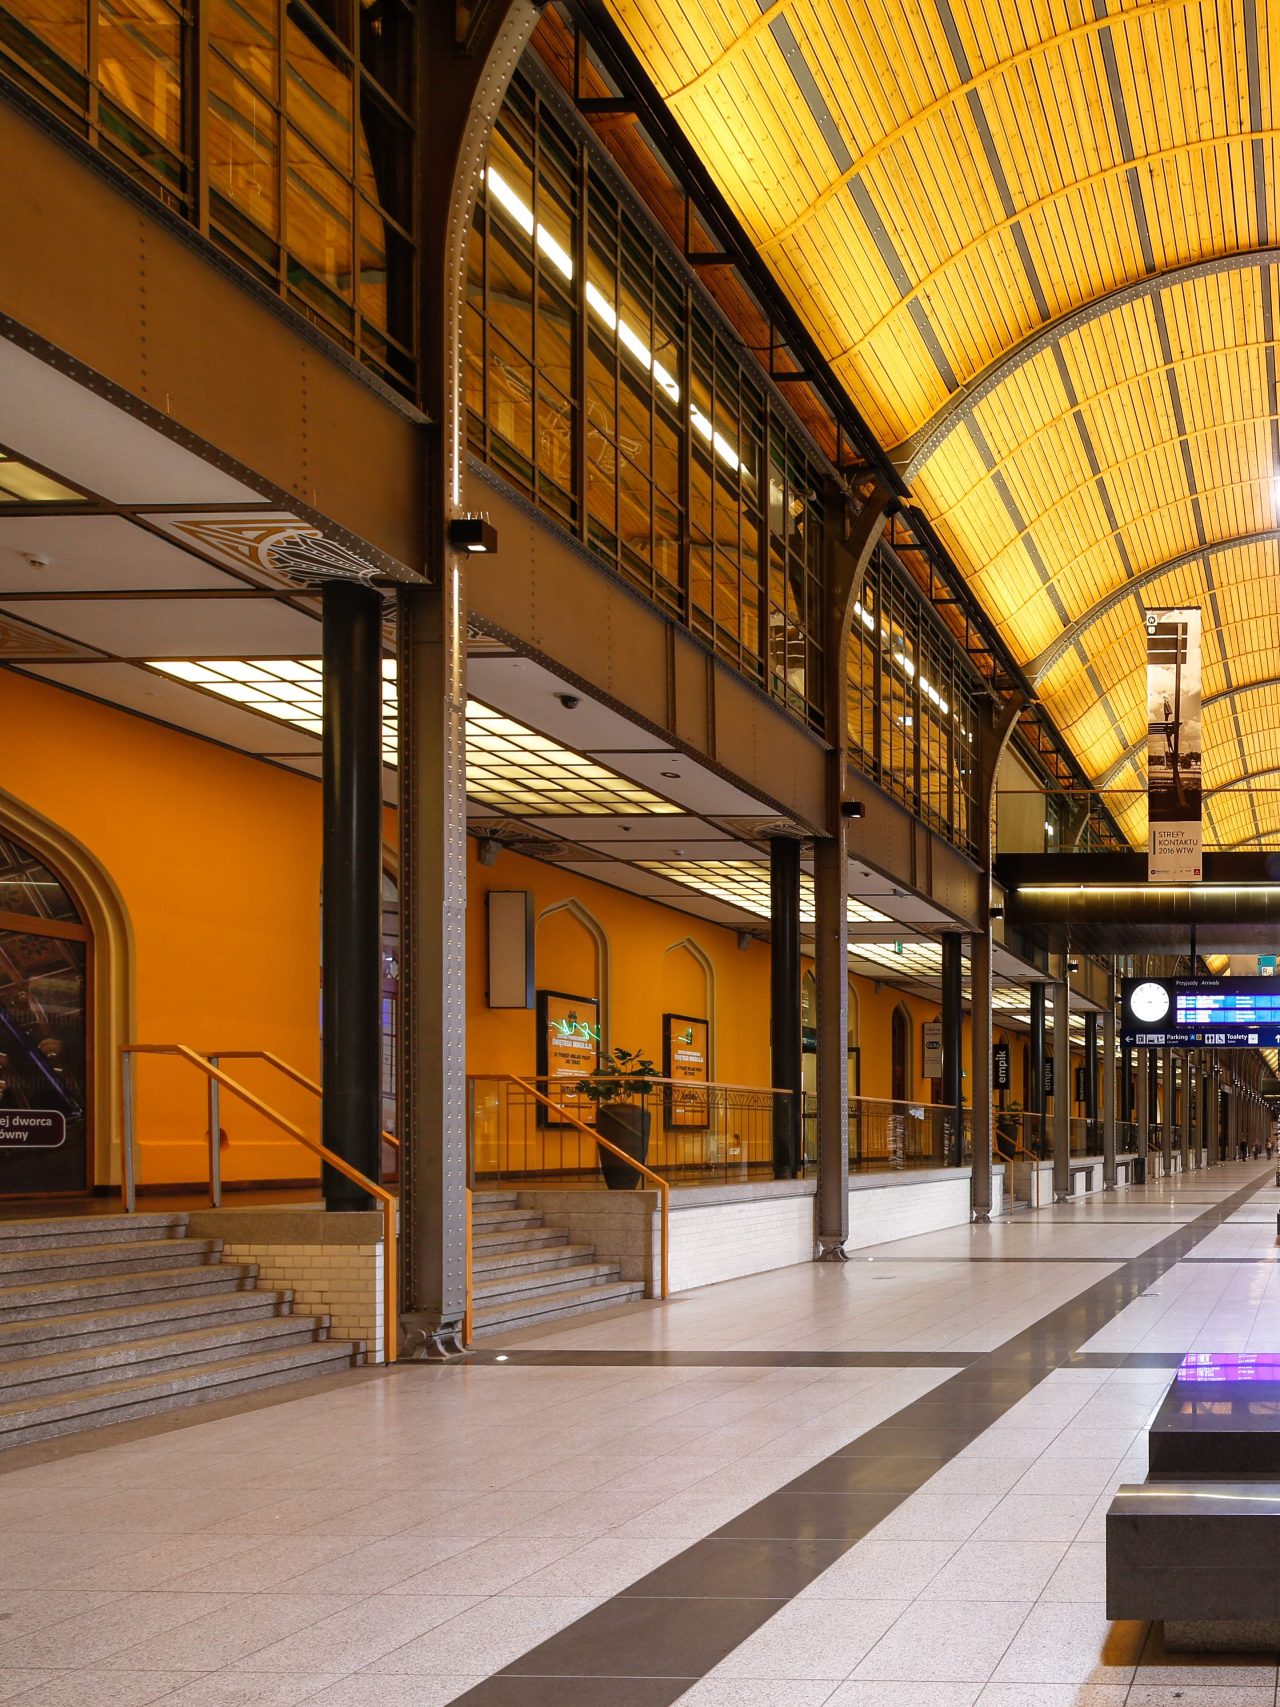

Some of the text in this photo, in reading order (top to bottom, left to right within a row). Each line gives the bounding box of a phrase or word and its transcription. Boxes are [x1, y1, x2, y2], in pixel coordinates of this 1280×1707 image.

[1158, 847, 1175, 855] 2016
[995, 1050, 1008, 1083] empik
[1044, 1063, 1053, 1091] empik
[12, 1115, 52, 1126] dworca
